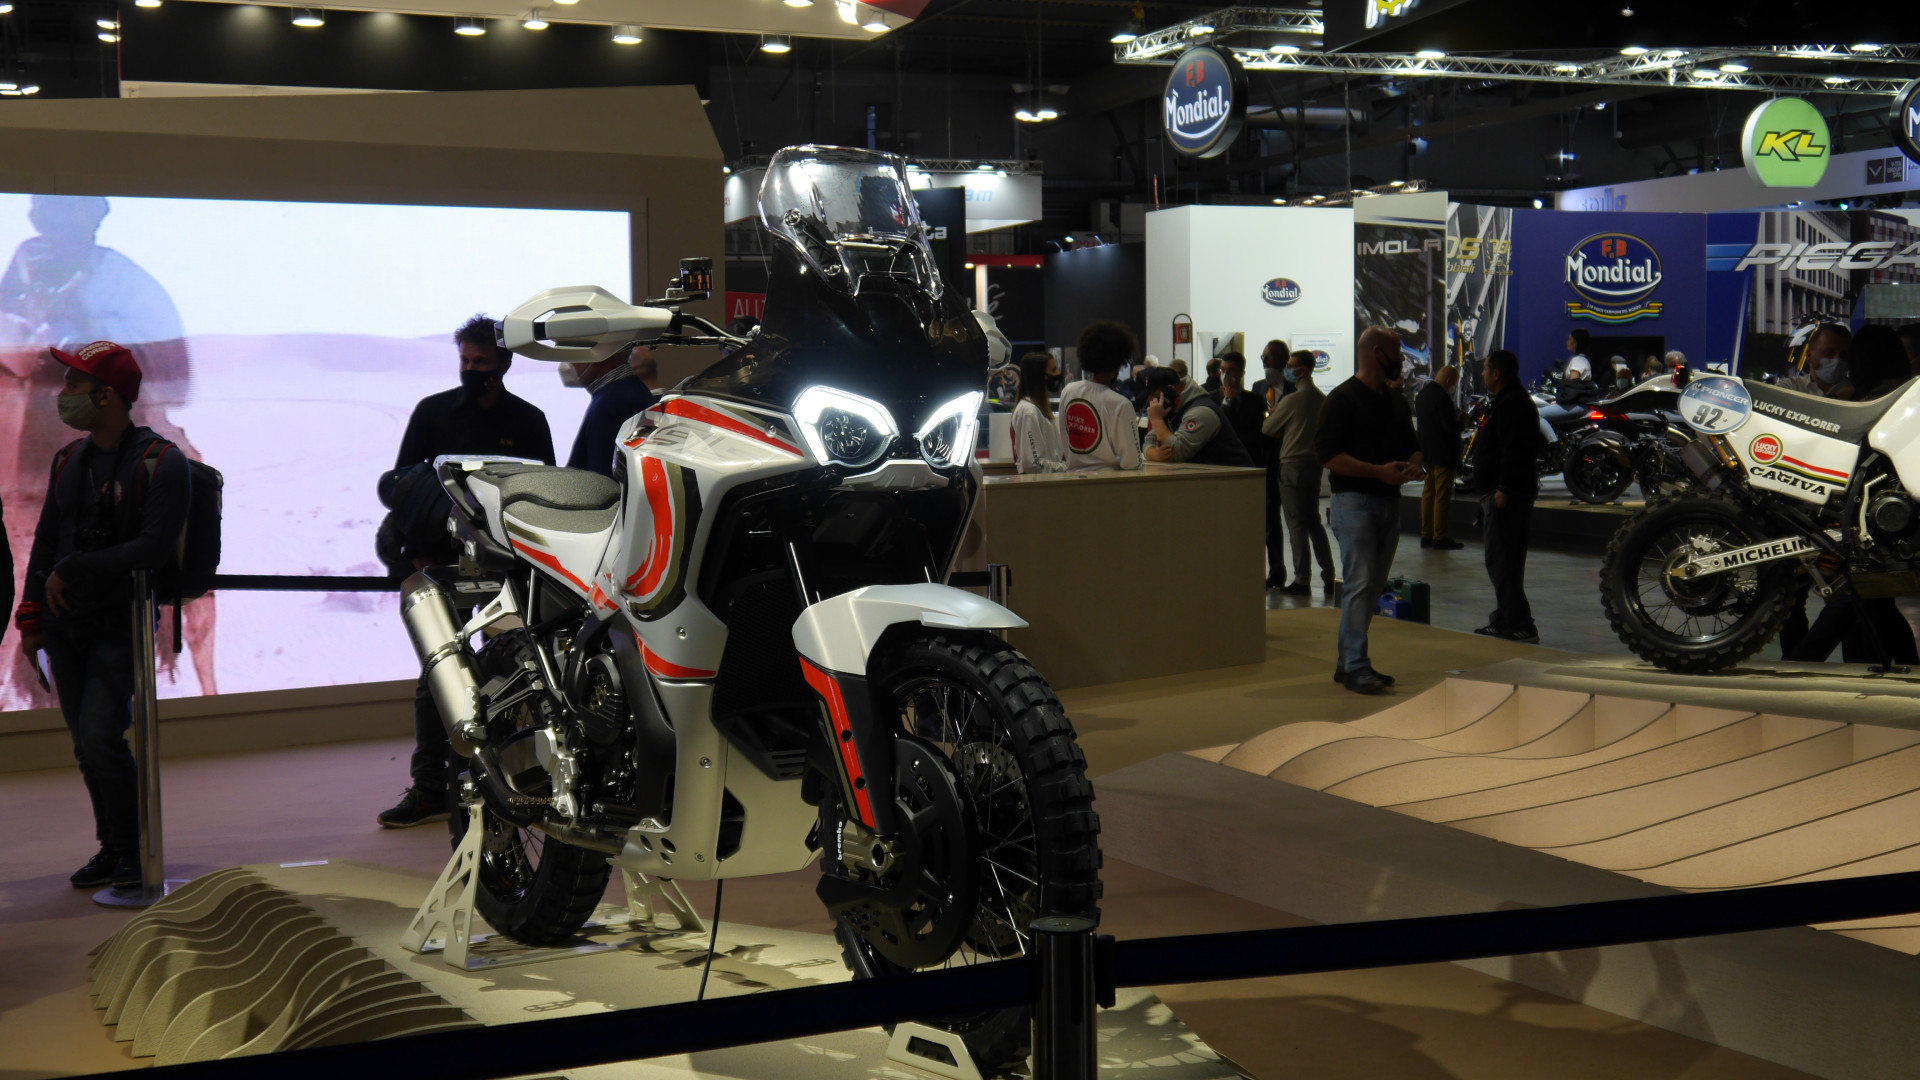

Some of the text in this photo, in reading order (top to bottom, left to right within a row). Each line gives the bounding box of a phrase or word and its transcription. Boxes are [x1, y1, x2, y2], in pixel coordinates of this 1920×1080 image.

[1164, 85, 1229, 136] Mondial
[1757, 129, 1826, 162] KL
[1357, 238, 1442, 256] IMOLA
[1566, 250, 1661, 293] Mondial
[1262, 284, 1301, 302] Mondial
[1701, 386, 1749, 406] PIONEER
[1692, 405, 1724, 430] 92
[1754, 400, 1787, 416] LUCKY
[1786, 410, 1840, 434] EXPLORER
[1755, 441, 1778, 451] LUCKY
[1749, 465, 1827, 496] CAGIVA
[1722, 538, 1812, 568] MICHELIN
